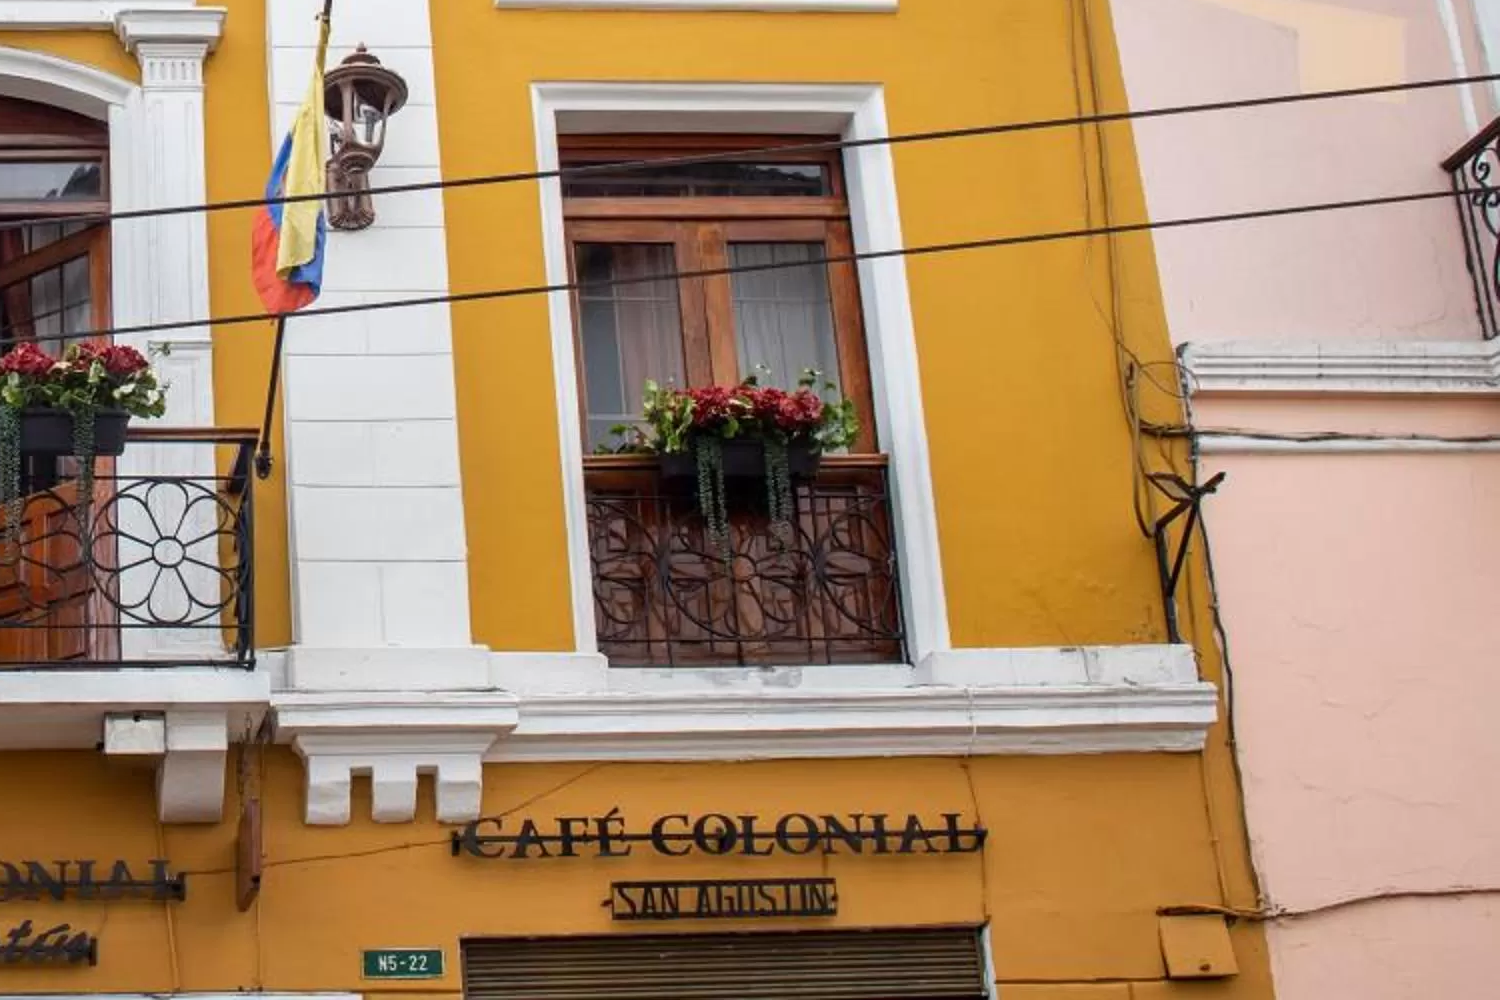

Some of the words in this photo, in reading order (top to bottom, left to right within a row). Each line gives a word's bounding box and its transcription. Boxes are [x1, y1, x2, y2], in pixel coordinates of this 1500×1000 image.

[463, 807, 632, 859] CAFÉ
[651, 813, 982, 857] COLONIAL
[616, 884, 679, 919] SAN
[378, 954, 428, 972] N5-22
